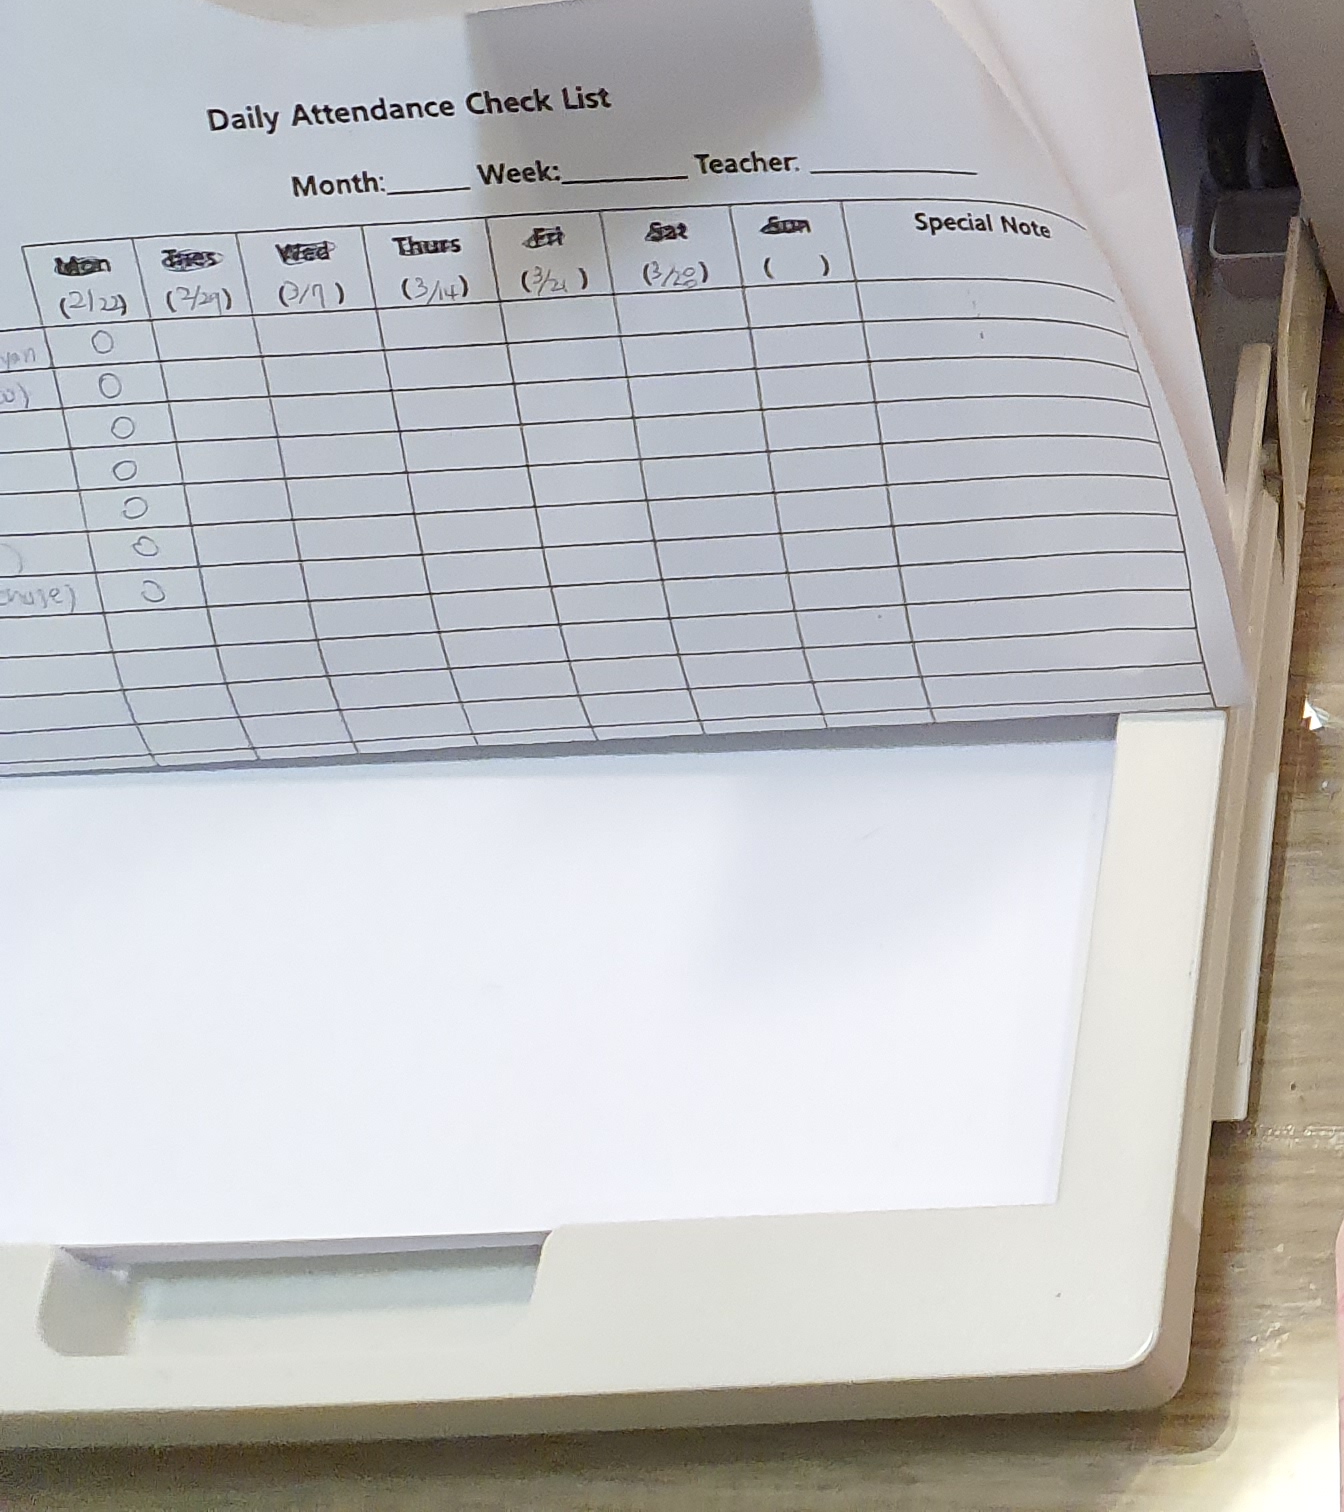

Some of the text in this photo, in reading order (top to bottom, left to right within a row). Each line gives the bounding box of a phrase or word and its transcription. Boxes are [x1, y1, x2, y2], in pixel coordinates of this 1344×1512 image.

[206, 85, 613, 135] Daily Attendance Check List
[914, 212, 994, 236] Special
[1000, 216, 1053, 239] Note
